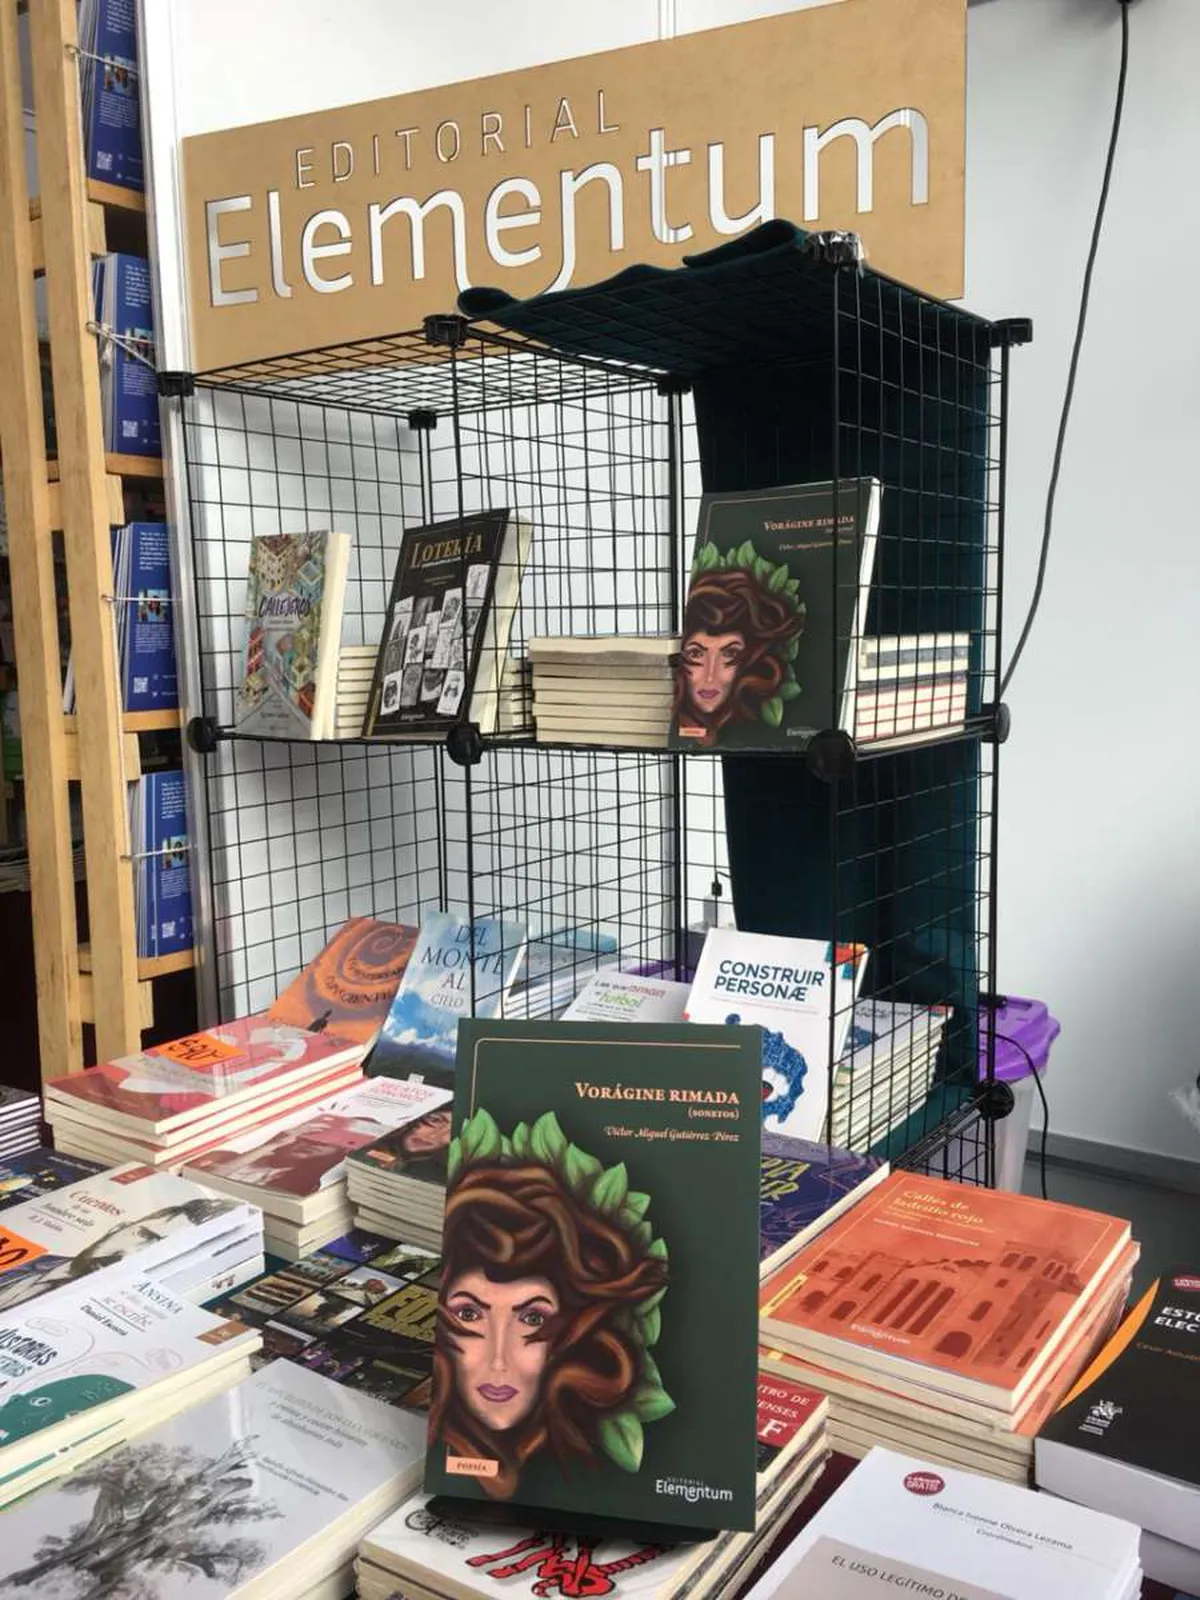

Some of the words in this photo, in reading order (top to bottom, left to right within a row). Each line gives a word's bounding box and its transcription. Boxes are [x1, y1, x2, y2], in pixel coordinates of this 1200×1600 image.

[294, 89, 620, 189] EDITORIAL
[205, 106, 929, 308] Elementum
[441, 971, 466, 991] AL
[719, 960, 826, 986] CONSTRUIR
[714, 975, 809, 1002] PERSONÆ
[575, 1081, 666, 1101] VORÁGINE
[668, 1088, 740, 1105] RIMADA
[1154, 1316, 1200, 1334] ELEC
[789, 1395, 810, 1406] DE
[655, 1479, 733, 1502] Elementum
[831, 1555, 846, 1568] EL
[849, 1561, 878, 1577] USO
[879, 1571, 944, 1599] LEGÍTIMO
